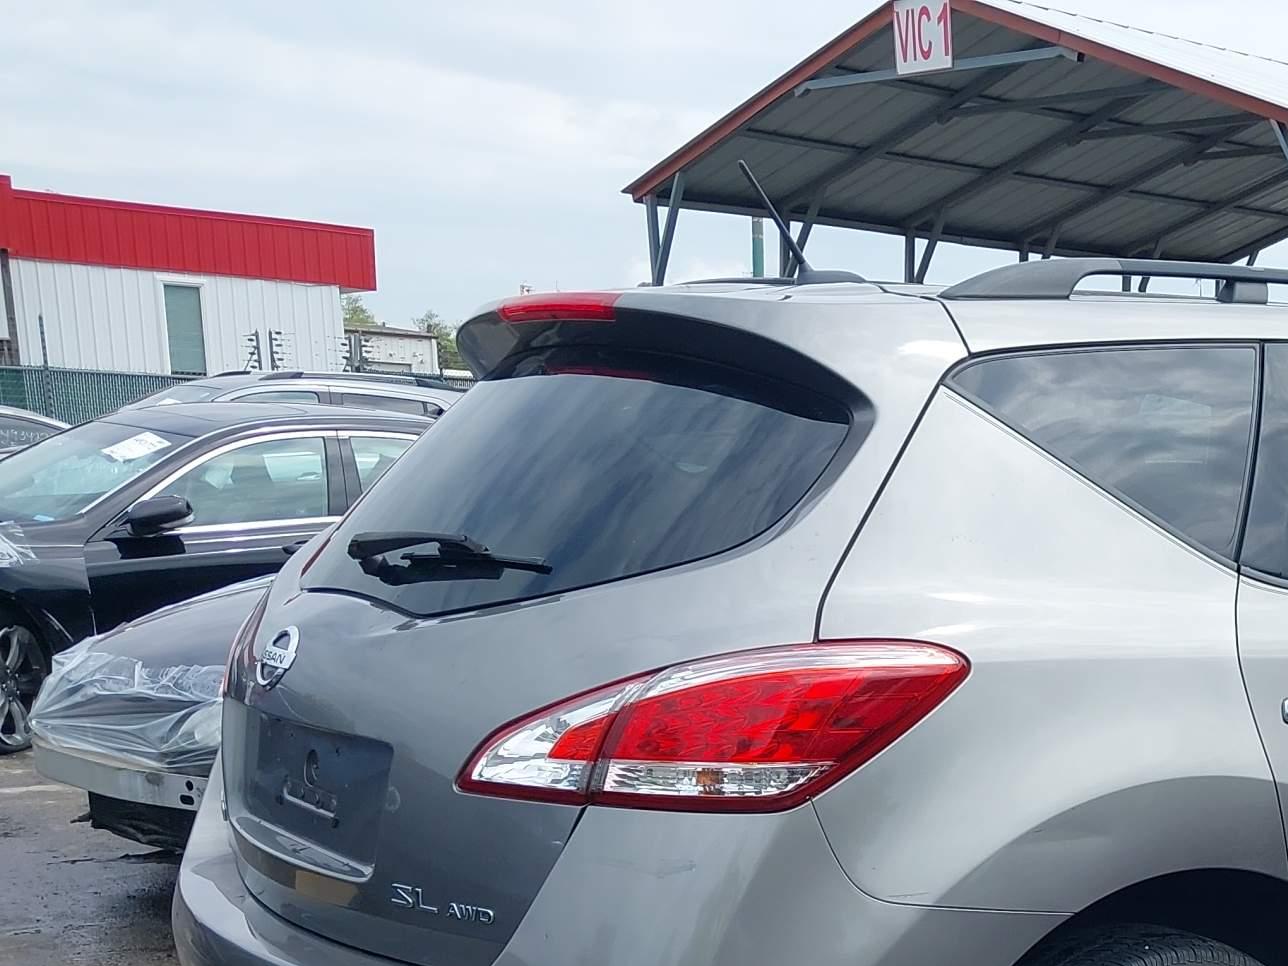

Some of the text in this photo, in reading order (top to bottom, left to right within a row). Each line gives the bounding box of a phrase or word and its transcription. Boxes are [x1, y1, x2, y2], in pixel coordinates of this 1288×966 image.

[895, 2, 950, 63] VIC 1
[261, 649, 287, 665] SSAN
[391, 883, 496, 925] SL AWD
